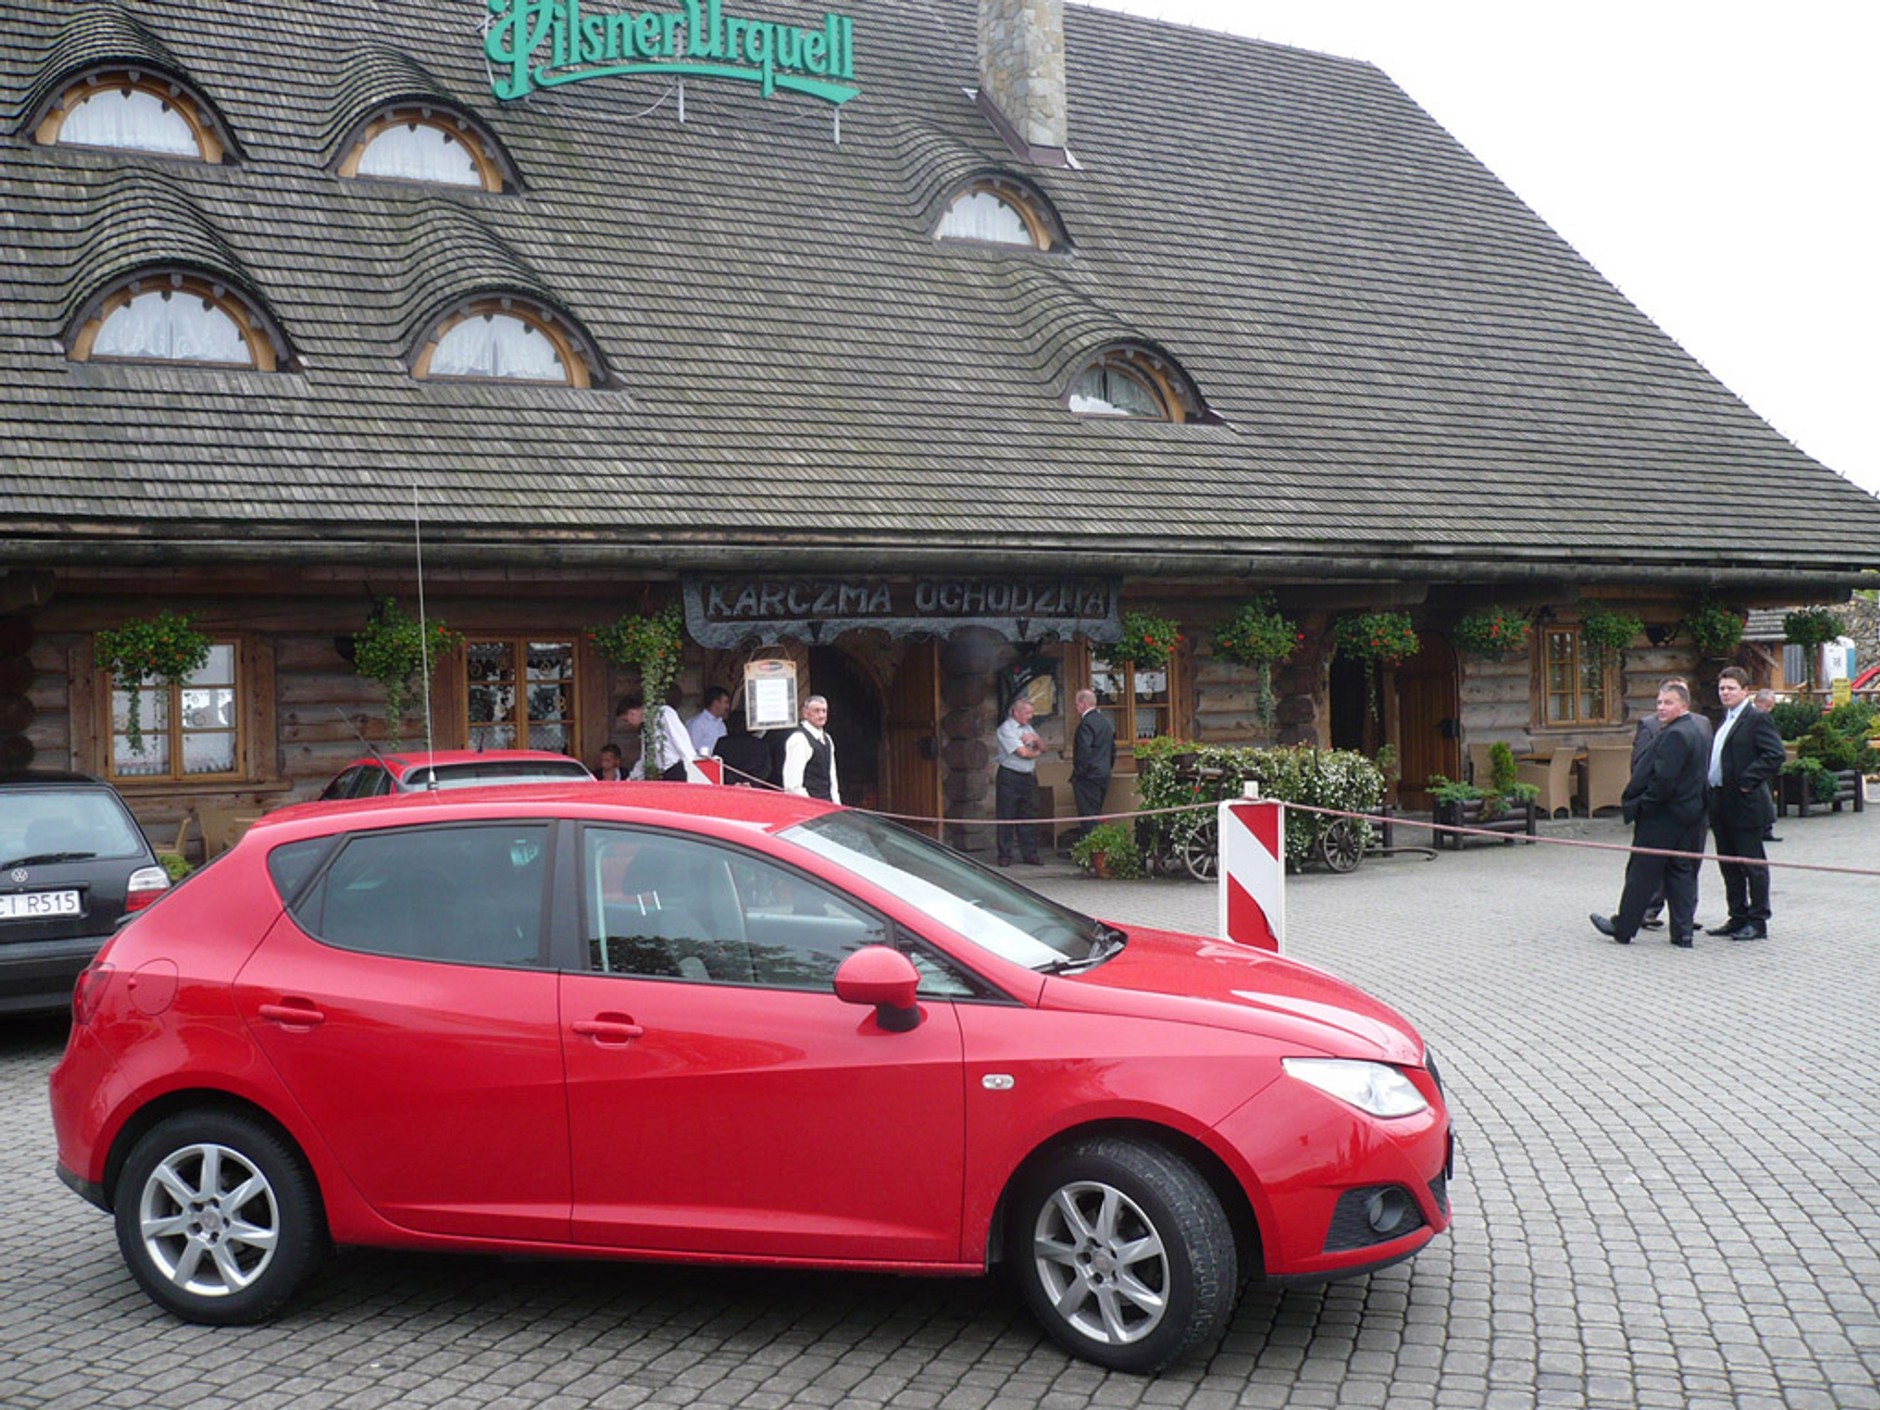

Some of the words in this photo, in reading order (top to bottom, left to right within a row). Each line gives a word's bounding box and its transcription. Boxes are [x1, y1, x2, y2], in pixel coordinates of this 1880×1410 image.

[485, 0, 685, 99] Pilsner
[682, 0, 853, 98] Urquell
[707, 582, 892, 616] KARCZMA
[27, 892, 76, 913] R515
